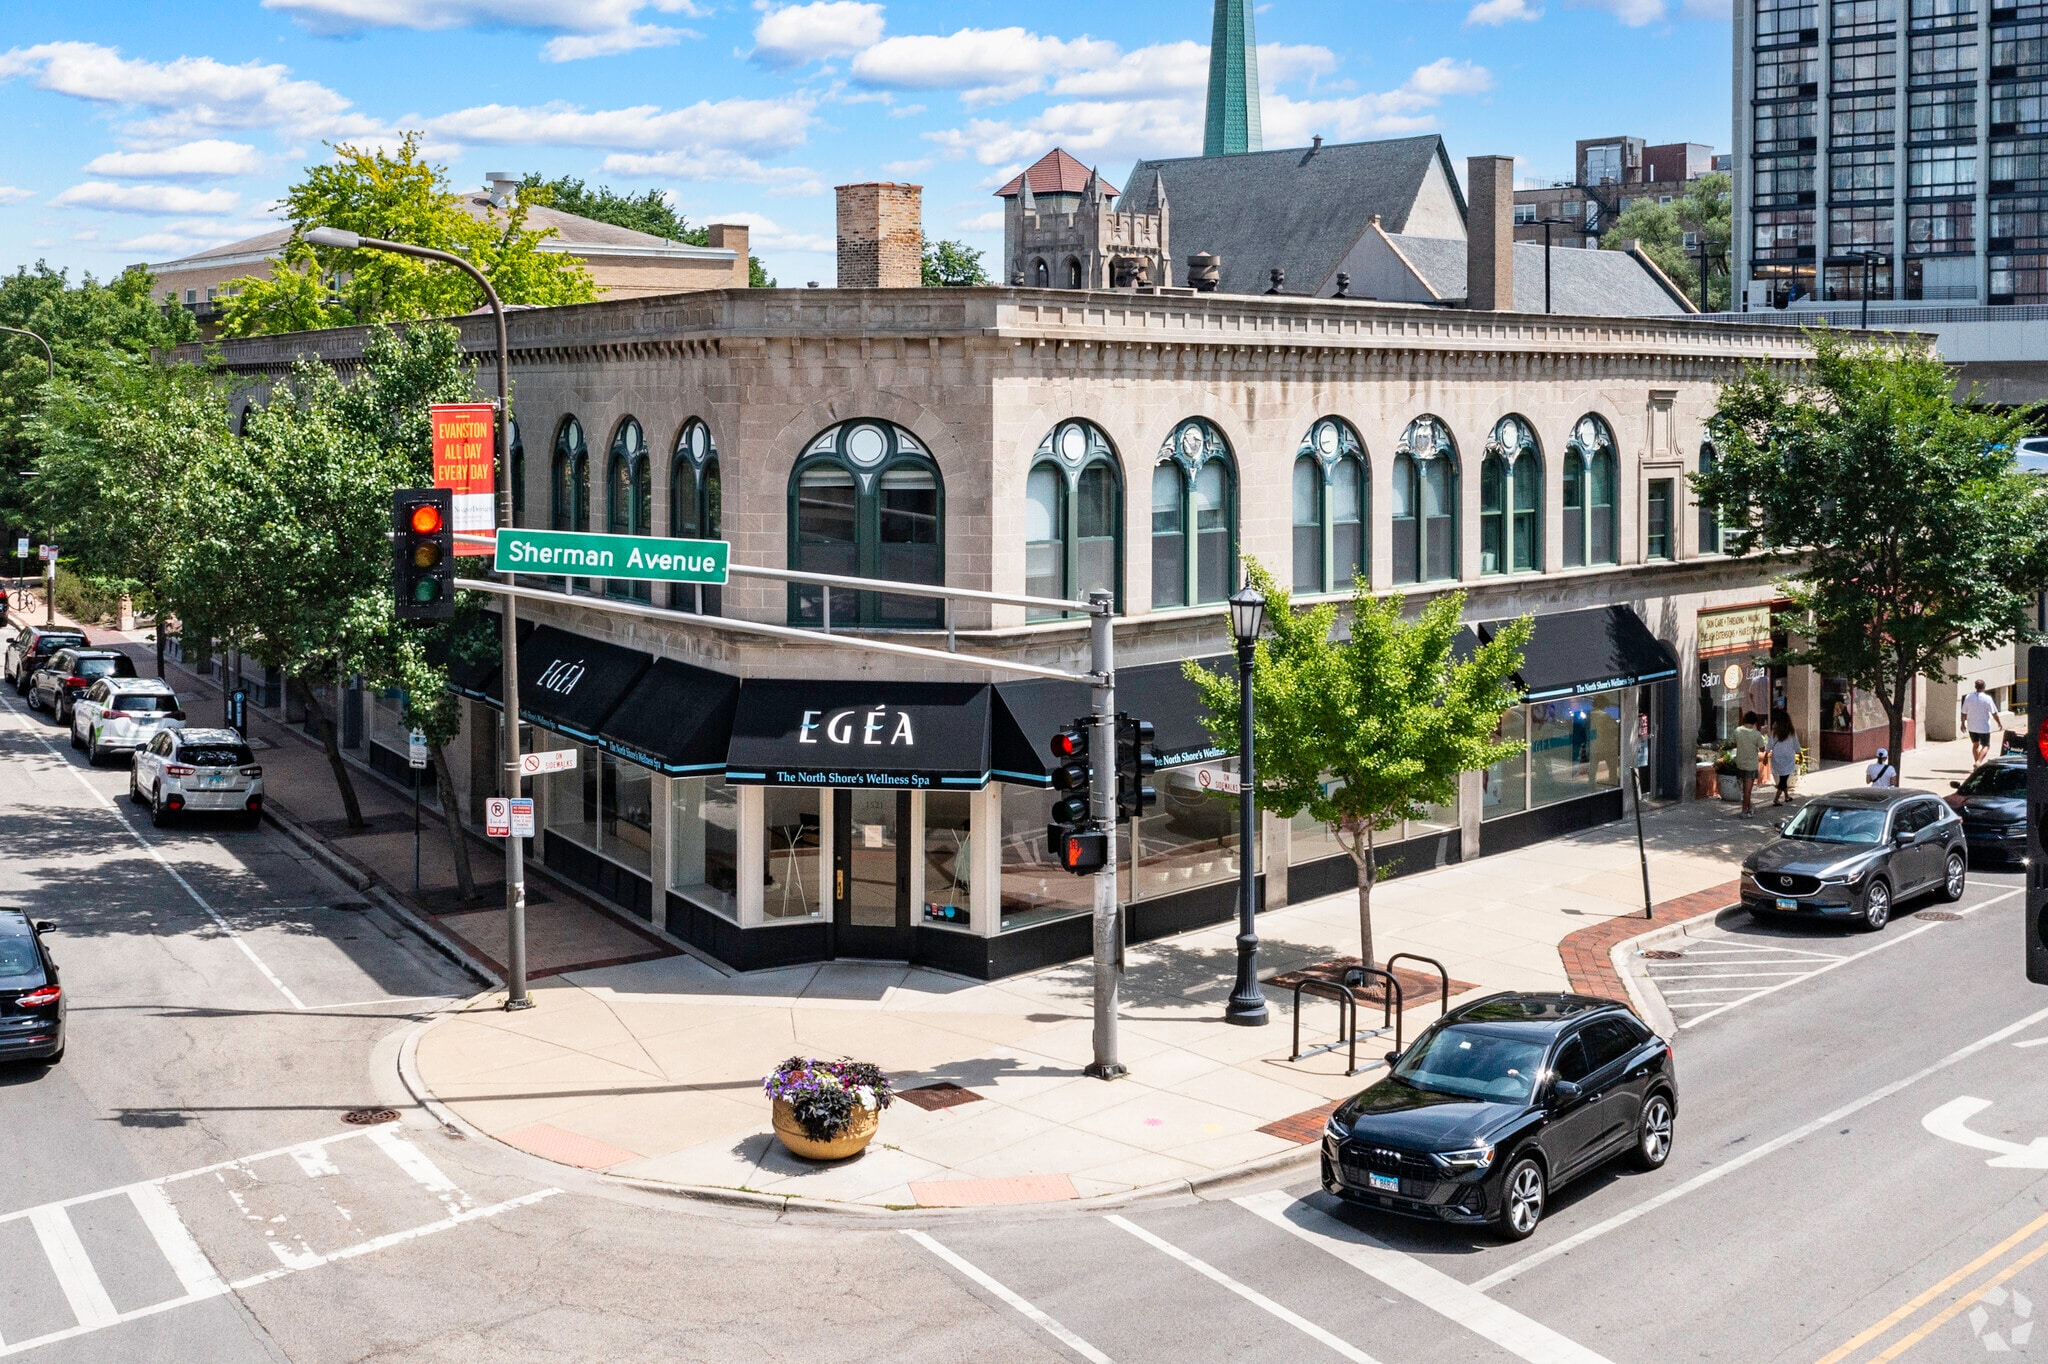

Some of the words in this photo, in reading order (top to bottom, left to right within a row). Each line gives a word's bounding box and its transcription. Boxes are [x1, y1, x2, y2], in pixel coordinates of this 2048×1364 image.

[439, 422, 487, 439] EVANSTON
[445, 443, 462, 459] ALL
[464, 443, 482, 459] DAY
[438, 464, 468, 480] EVERY
[470, 464, 488, 480] DAY
[508, 540, 614, 567] Sherman
[626, 547, 716, 572] Avenue
[1715, 618, 1723, 627] CARE
[1727, 616, 1744, 625] THREADING
[1716, 630, 1735, 640] EXTENSIONS
[536, 658, 586, 695] EGÉA
[1701, 672, 1720, 688] Salon
[1576, 684, 1584, 693] The
[1584, 682, 1596, 691] North
[799, 704, 914, 745] EGÉA
[545, 760, 573, 769] SIDEWALKS
[1163, 753, 1180, 765] North
[1182, 750, 1202, 762] Shore's
[776, 771, 796, 782] The
[798, 772, 826, 783] North
[828, 773, 863, 784] Shore's
[866, 773, 909, 785] Wellness
[912, 774, 930, 787] Spa
[1215, 781, 1238, 792] SIDEWALKS
